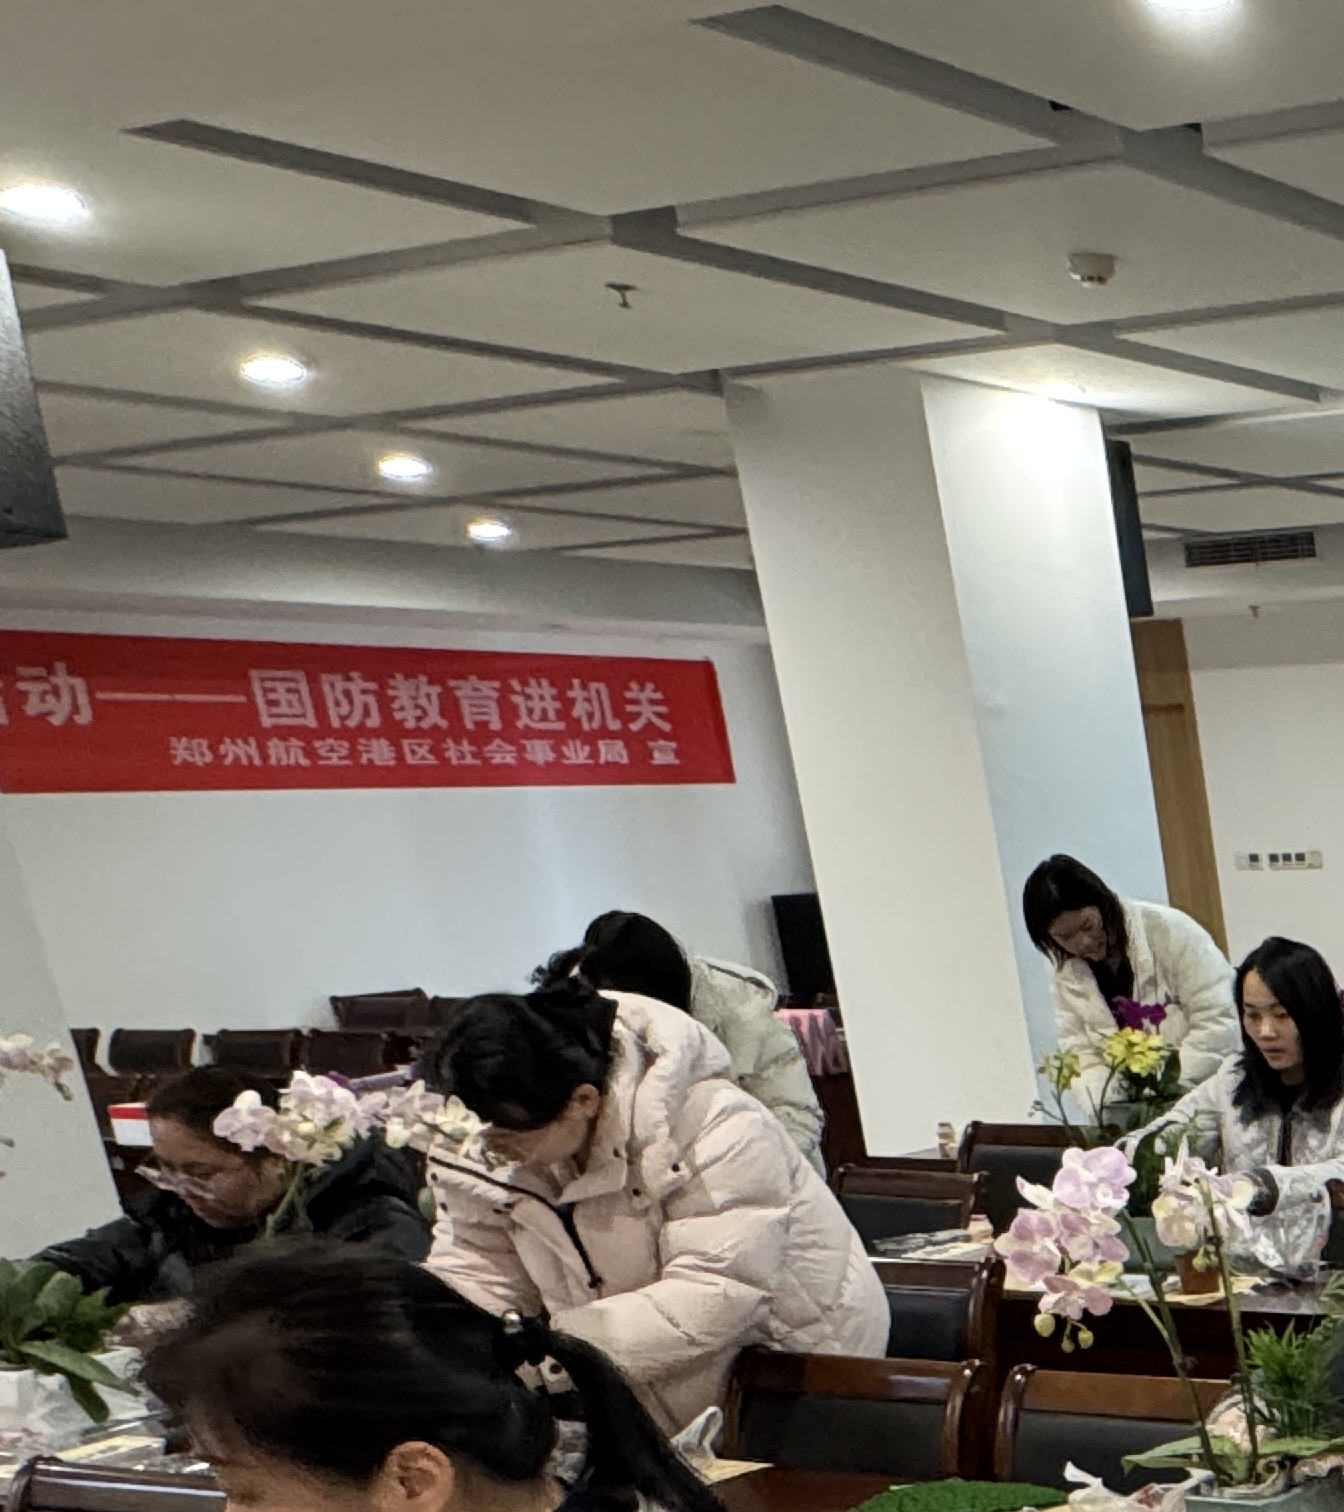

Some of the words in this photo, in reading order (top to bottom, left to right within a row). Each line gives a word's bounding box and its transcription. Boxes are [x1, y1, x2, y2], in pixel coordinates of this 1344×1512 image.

[0, 660, 673, 732] 动——国防教育进机关
[168, 734, 631, 767] 郑州航空港区社会事业局
[649, 739, 680, 765] 宣
